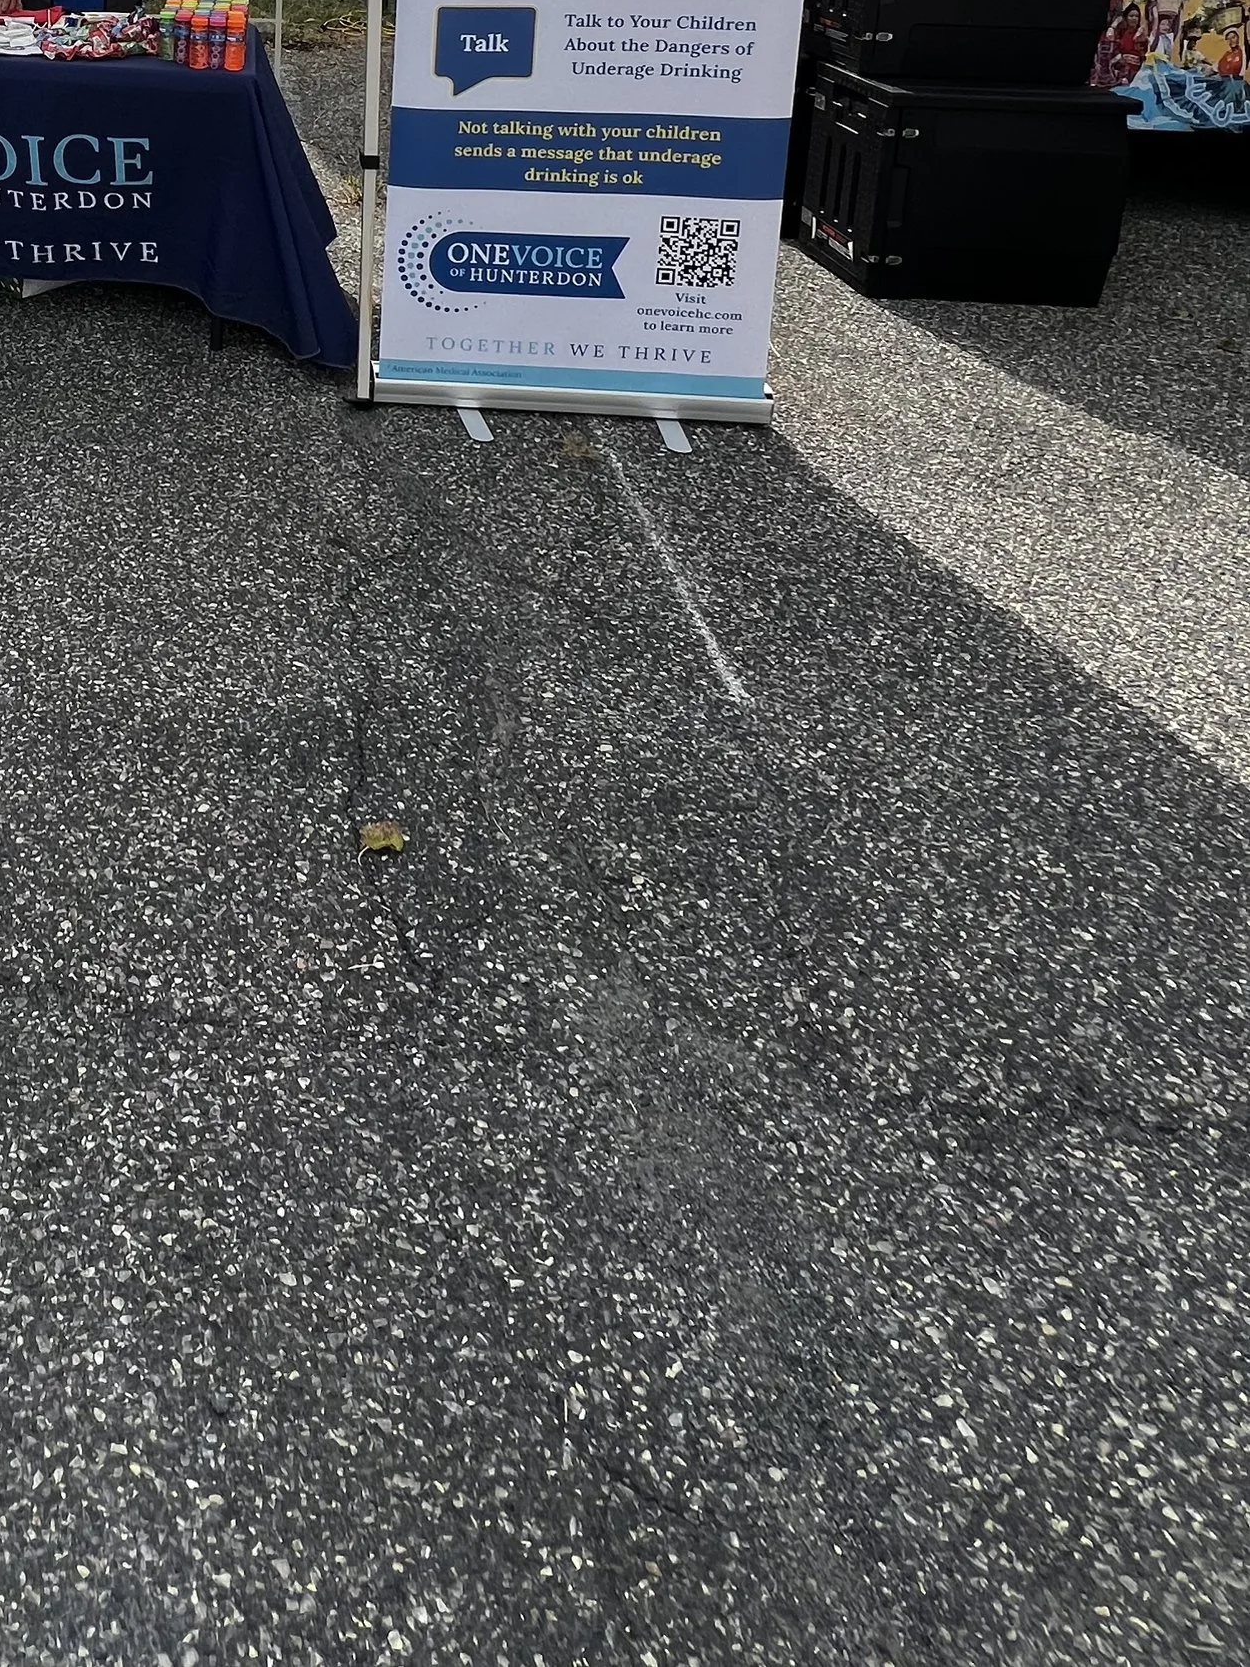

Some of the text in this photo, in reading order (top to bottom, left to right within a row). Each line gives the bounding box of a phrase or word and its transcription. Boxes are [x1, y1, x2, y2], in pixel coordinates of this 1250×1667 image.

[564, 14, 757, 31] Talk to Your Children
[460, 33, 510, 53] Talk
[564, 38, 754, 57] About the Dangers of
[571, 61, 742, 83] Underage Drinking
[458, 121, 721, 141] Not talking with your children
[454, 144, 721, 167] sends a message that underage
[524, 168, 643, 186] drinking is ok
[5, 239, 160, 264] THRIVE
[447, 242, 603, 269] ONEVOICE
[450, 268, 602, 286] OF HUNTERDON
[675, 293, 706, 304] Visit
[637, 306, 742, 320] onevoicehc.com
[644, 321, 733, 334] to learn more
[426, 336, 712, 364] TOGETHER WE THRIVE
[436, 365, 469, 376] Medical
[471, 367, 522, 378] Association
